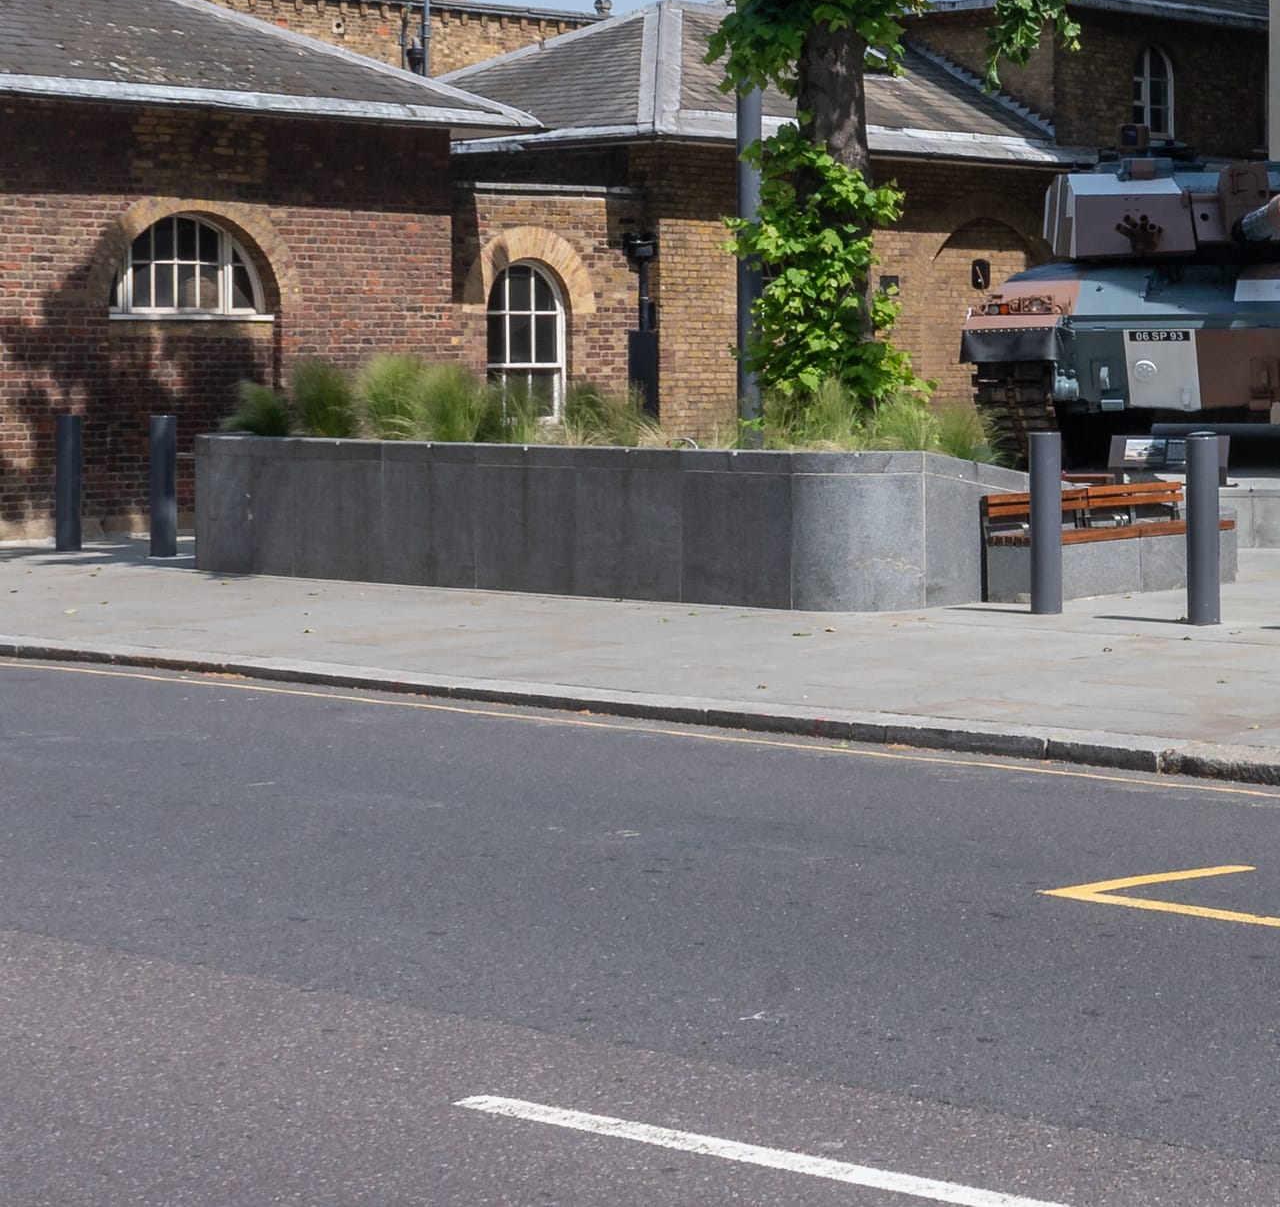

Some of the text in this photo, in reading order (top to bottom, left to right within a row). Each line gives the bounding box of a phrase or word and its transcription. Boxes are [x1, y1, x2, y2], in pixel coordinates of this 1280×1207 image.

[1135, 331, 1184, 341] 06 SP 93
